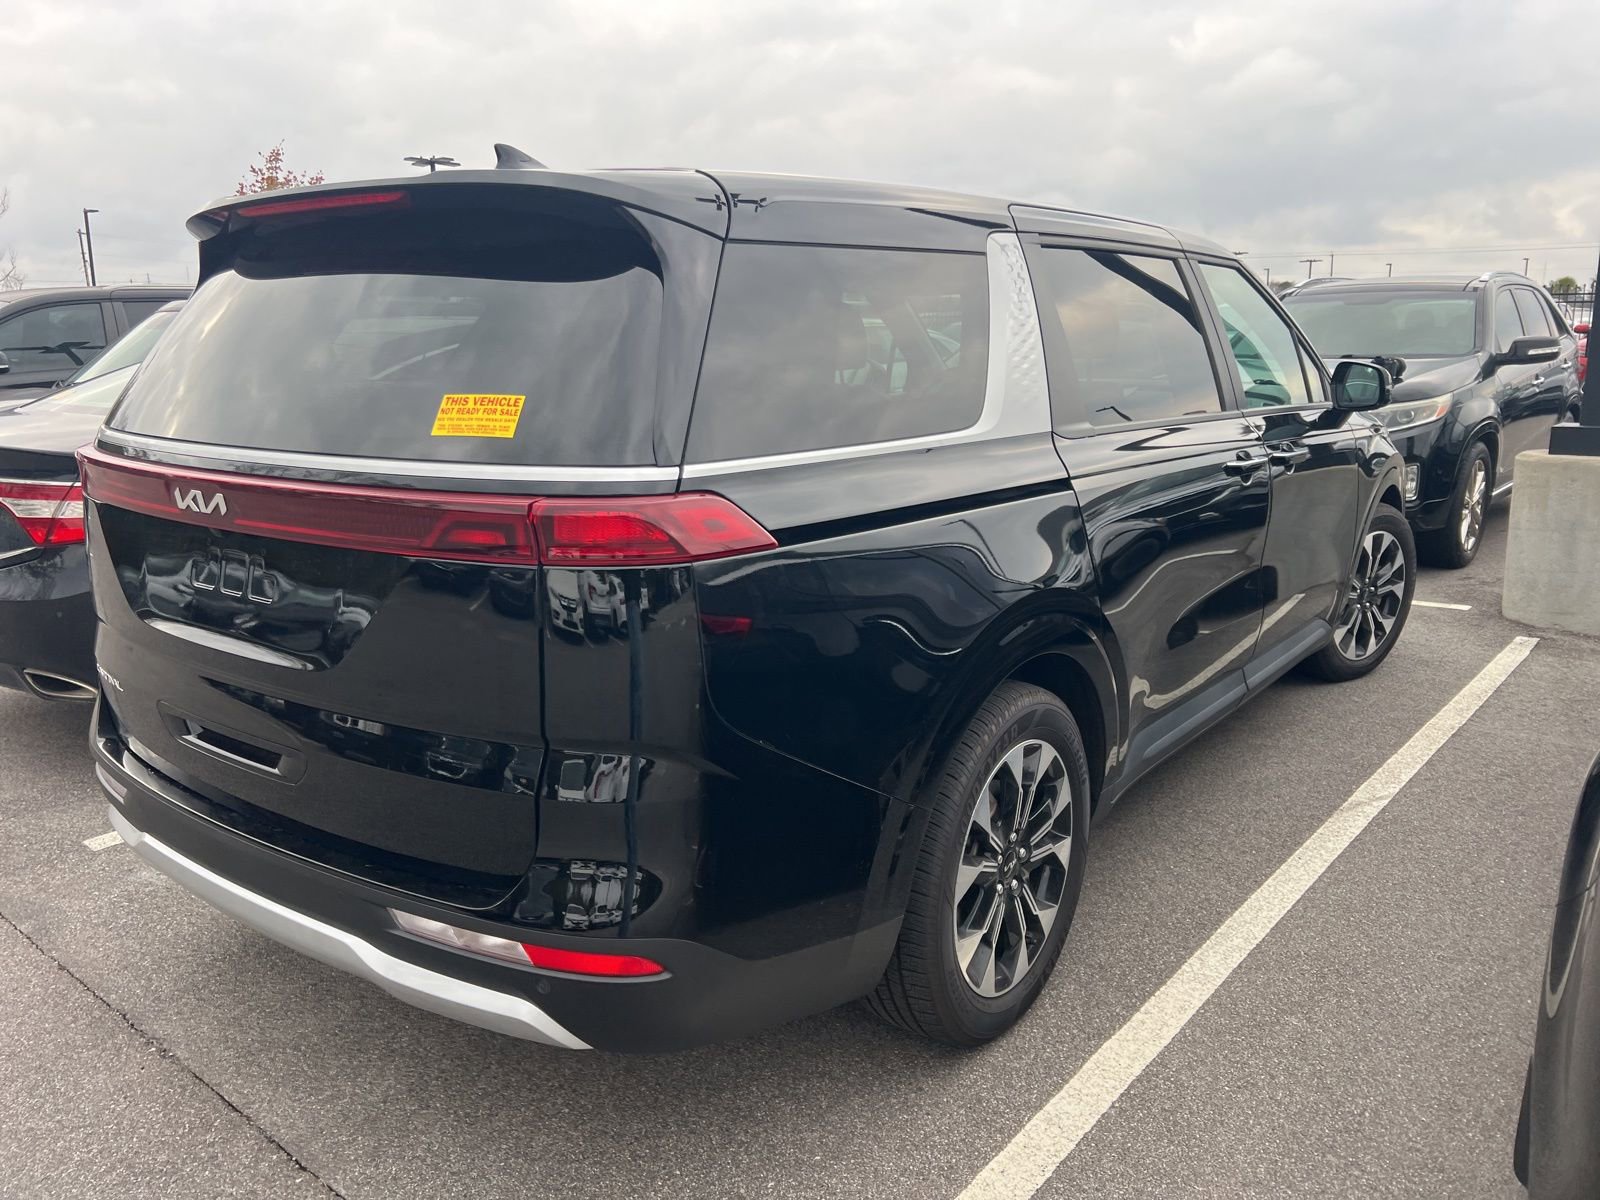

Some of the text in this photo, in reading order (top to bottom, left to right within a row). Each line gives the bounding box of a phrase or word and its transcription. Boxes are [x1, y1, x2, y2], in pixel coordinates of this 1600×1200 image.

[445, 396, 522, 408] THIS VEHICLE
[440, 407, 519, 417] NOT READY FOR SALE
[174, 487, 228, 516] KIA
